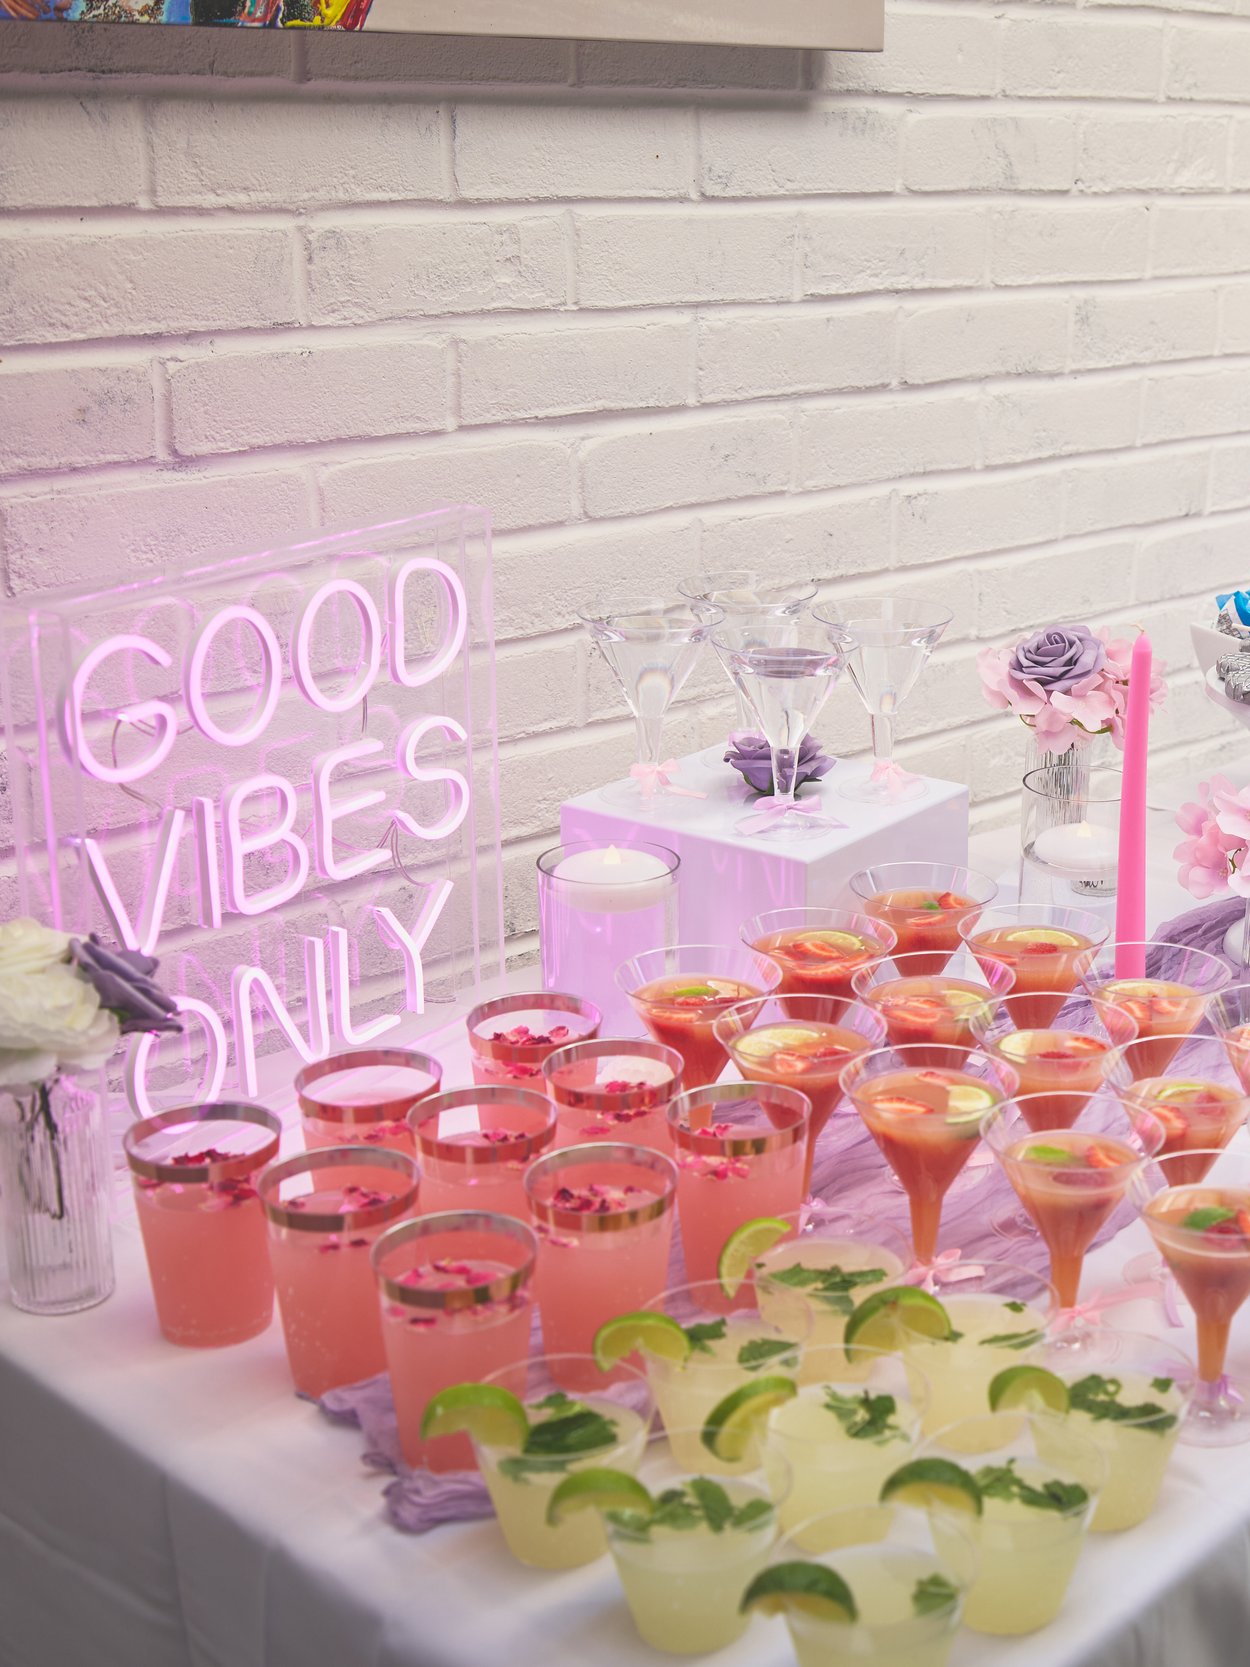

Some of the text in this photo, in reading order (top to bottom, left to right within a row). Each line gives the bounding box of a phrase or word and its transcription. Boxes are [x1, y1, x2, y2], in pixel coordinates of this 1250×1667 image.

[61, 556, 468, 784] GOOD
[77, 716, 471, 955] VIBES
[126, 880, 455, 1134] ONLY
